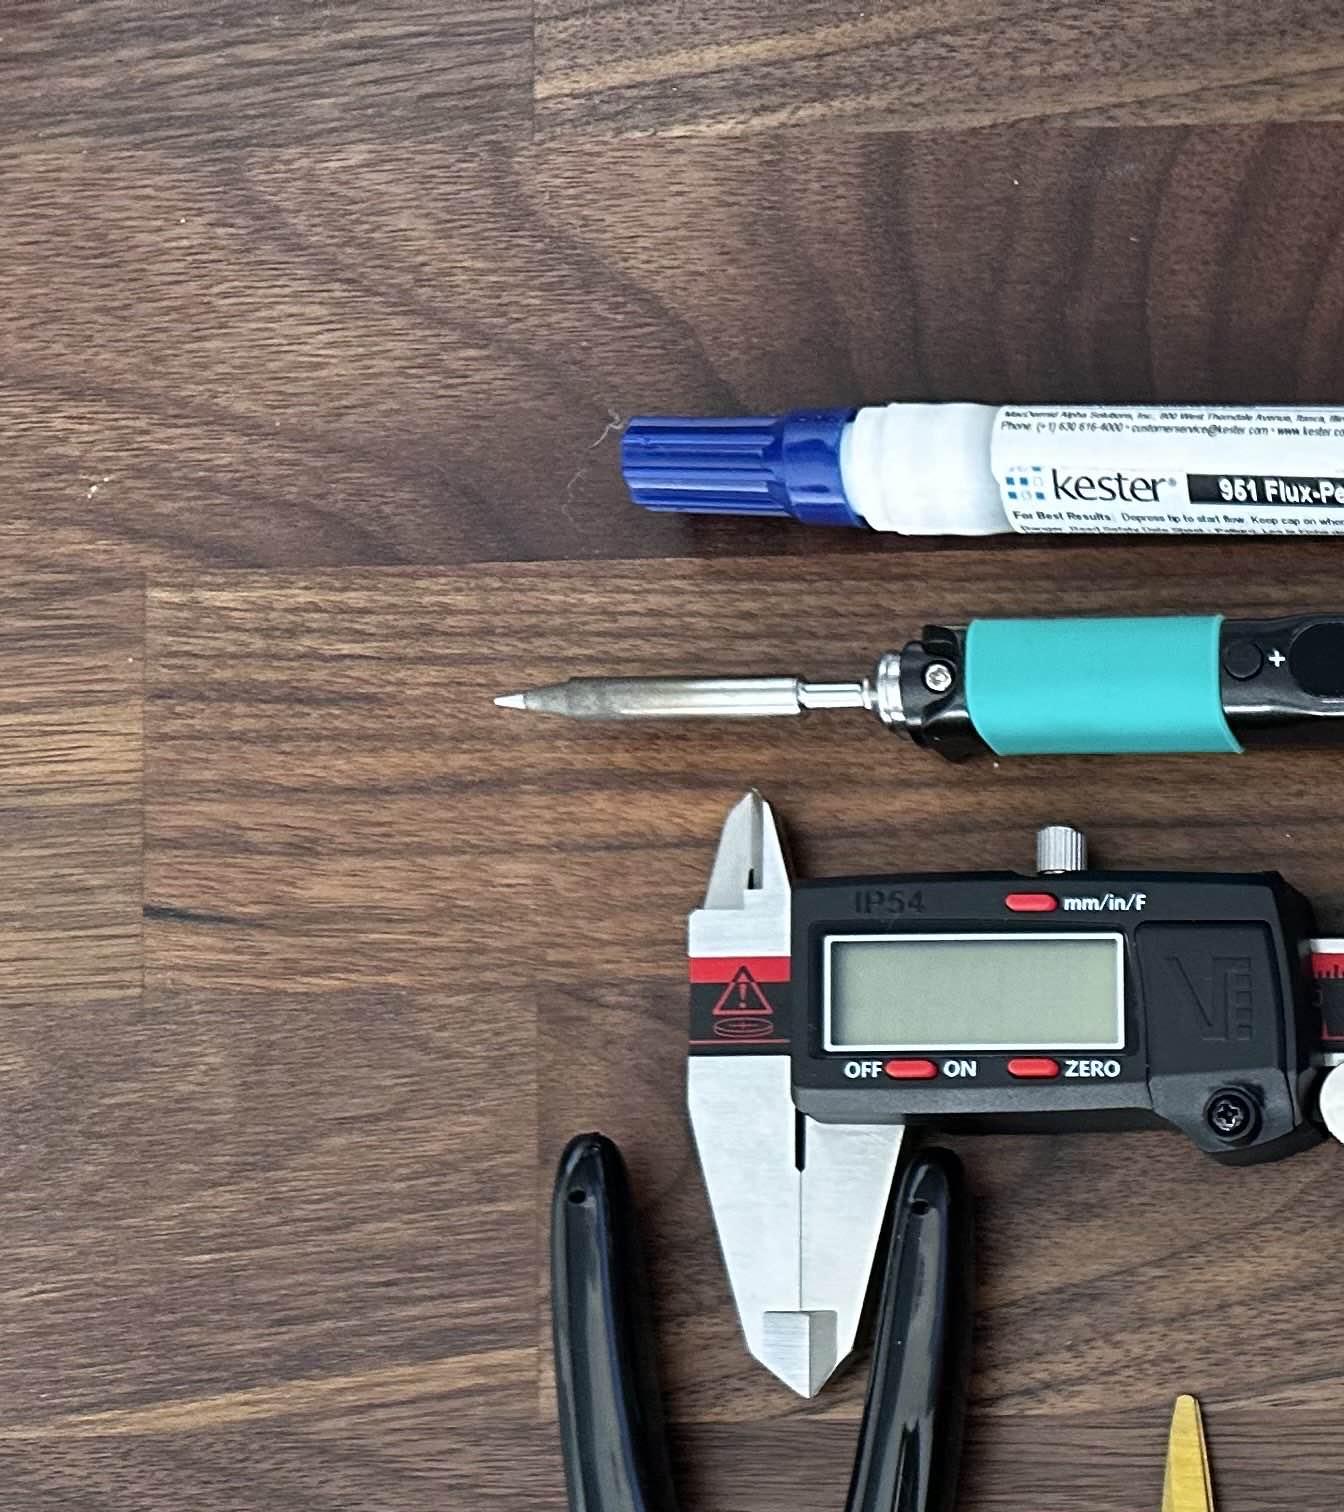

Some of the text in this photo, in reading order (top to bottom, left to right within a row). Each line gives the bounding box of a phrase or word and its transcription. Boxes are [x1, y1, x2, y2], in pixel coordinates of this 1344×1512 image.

[1012, 511, 1034, 520] For
[1037, 511, 1063, 521] Best
[1250, 516, 1279, 525] Keep
[1281, 518, 1301, 526] cap
[855, 891, 926, 914] IP54
[1063, 894, 1147, 911] mm/in/F
[844, 1060, 1121, 1079] OFF ON ZERO
